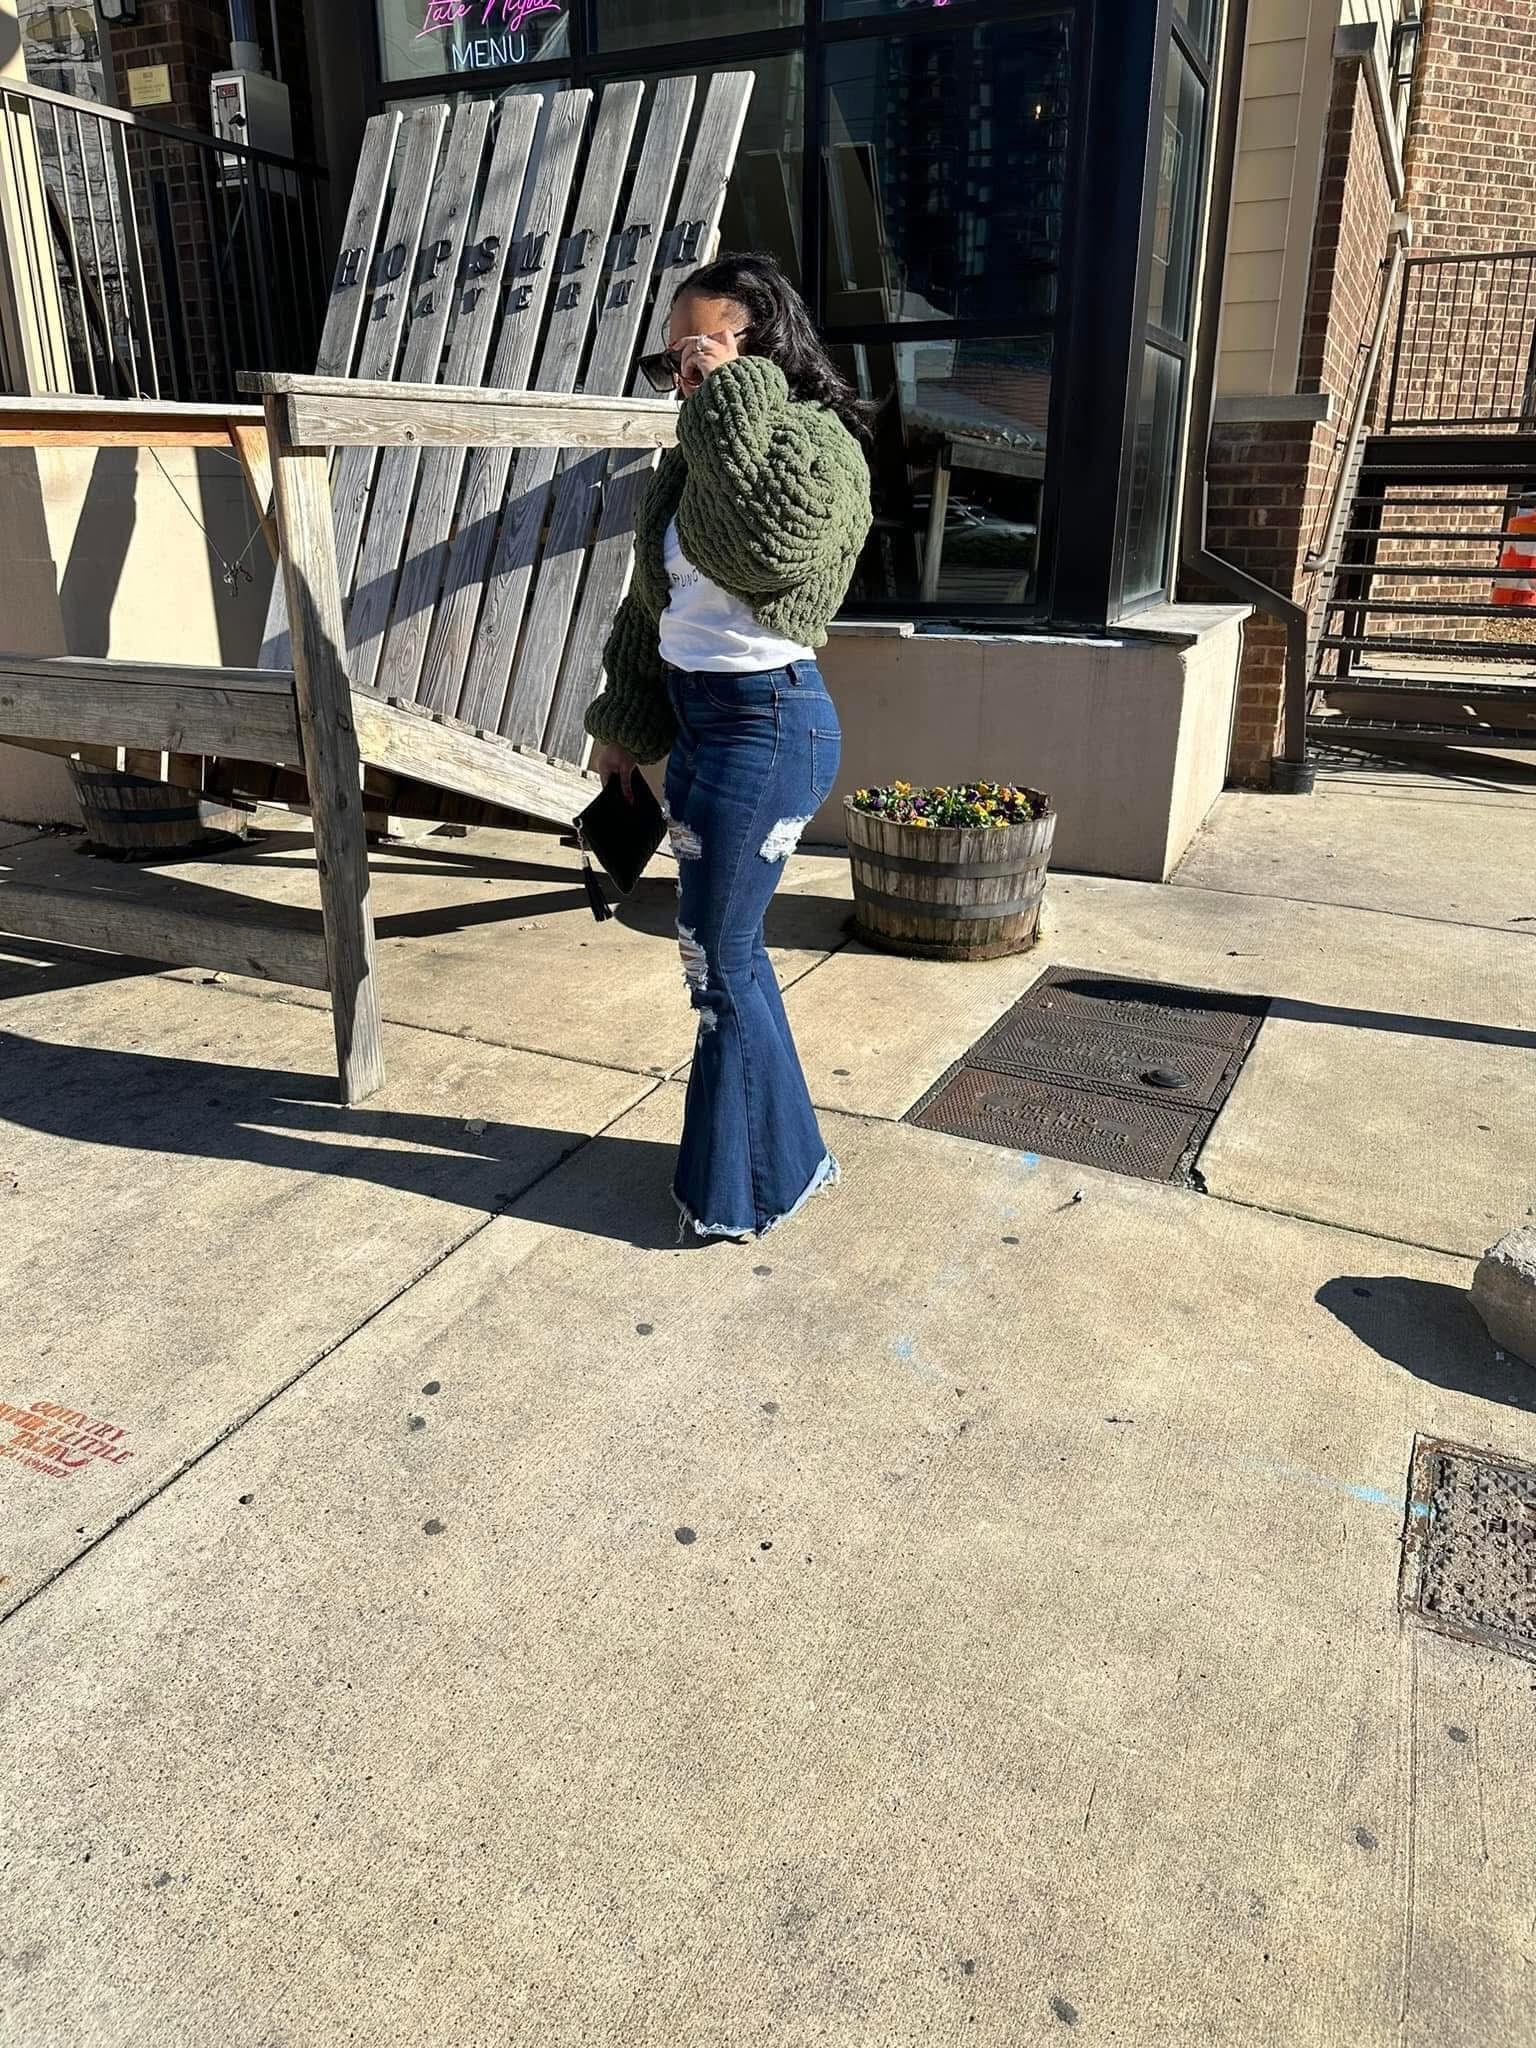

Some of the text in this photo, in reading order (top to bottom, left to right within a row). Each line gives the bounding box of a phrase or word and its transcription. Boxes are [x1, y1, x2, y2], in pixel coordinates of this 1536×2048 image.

[451, 34, 525, 70] MENU
[338, 220, 707, 287] HOPSMITH
[1022, 1102, 1099, 1125] METRO
